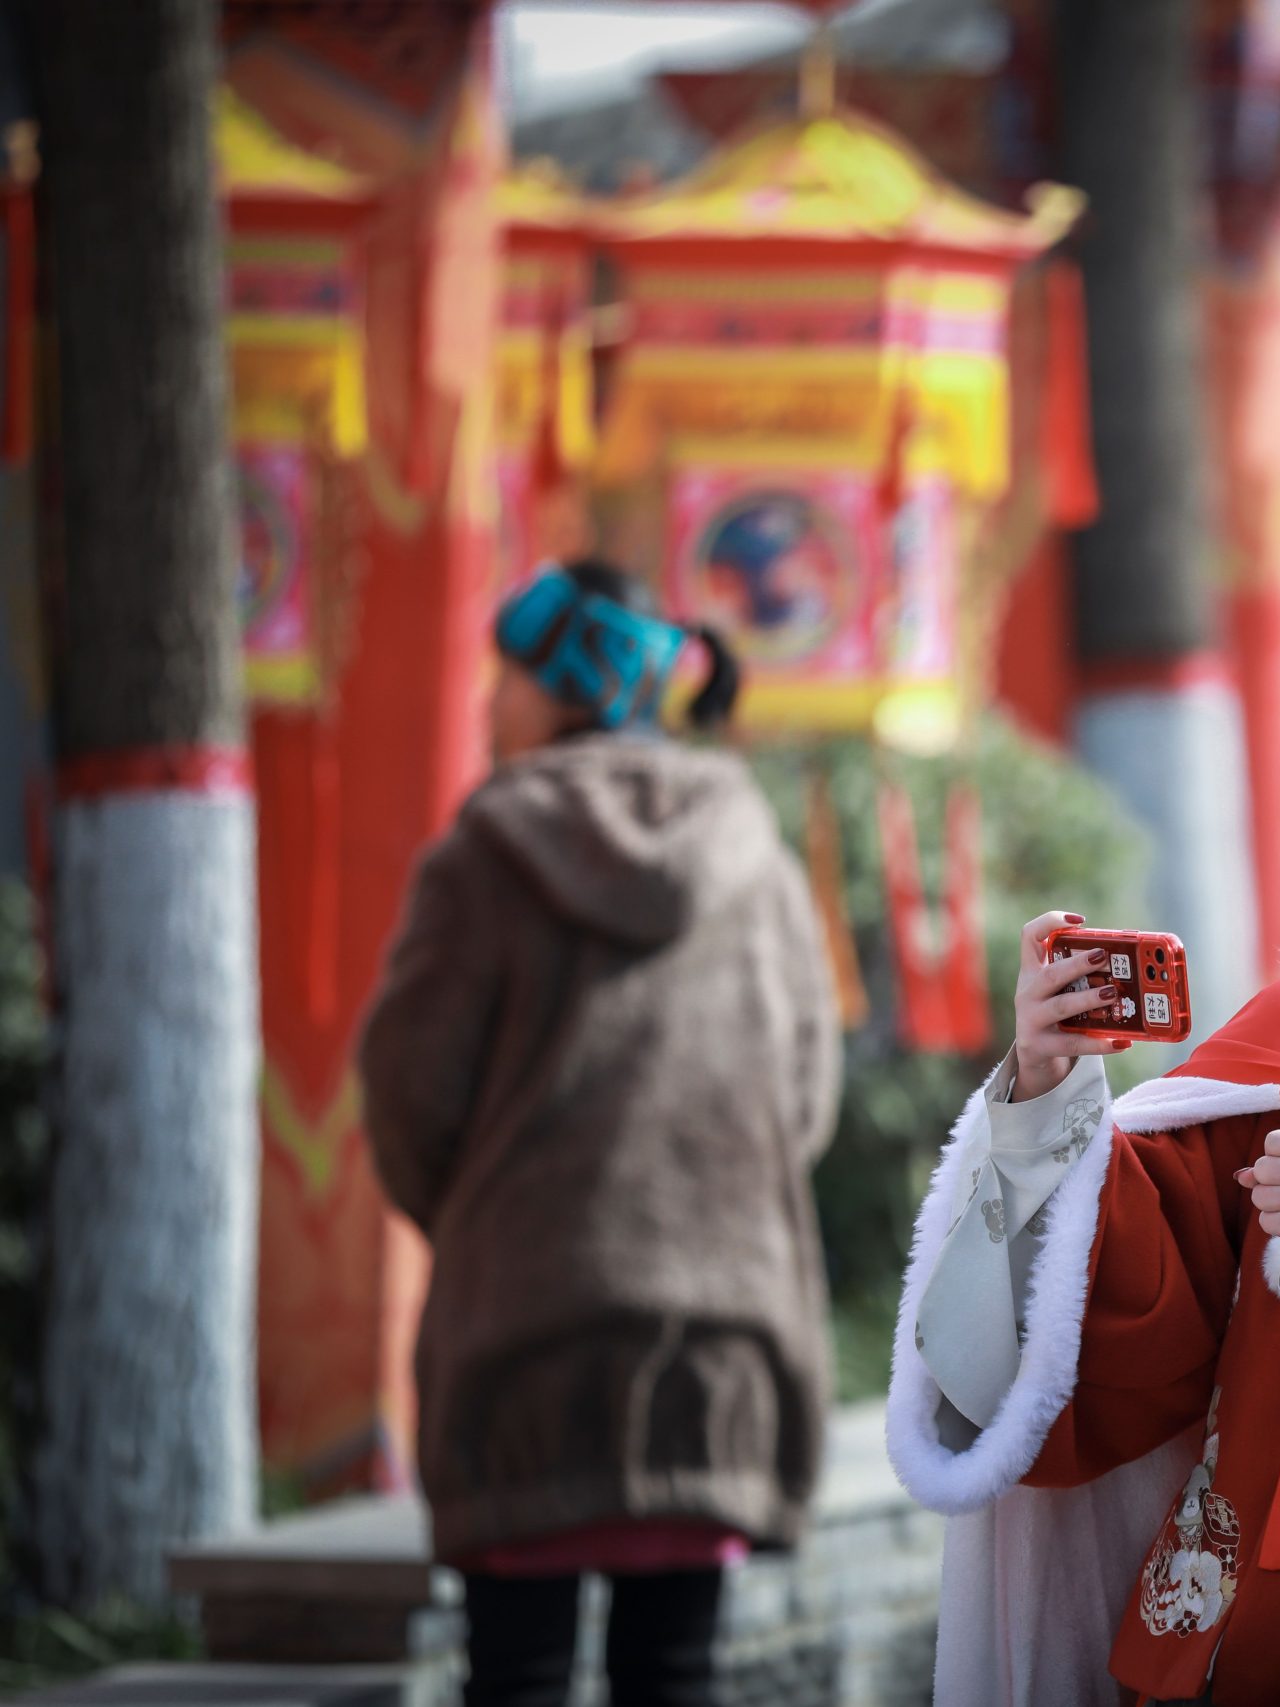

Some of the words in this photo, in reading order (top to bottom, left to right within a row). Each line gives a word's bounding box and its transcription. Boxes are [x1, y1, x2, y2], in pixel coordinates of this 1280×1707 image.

[1113, 956, 1121, 976] 大利
[1121, 957, 1128, 976] 大吉
[1147, 996, 1156, 1020] 大利
[1156, 996, 1166, 1020] 大吉
